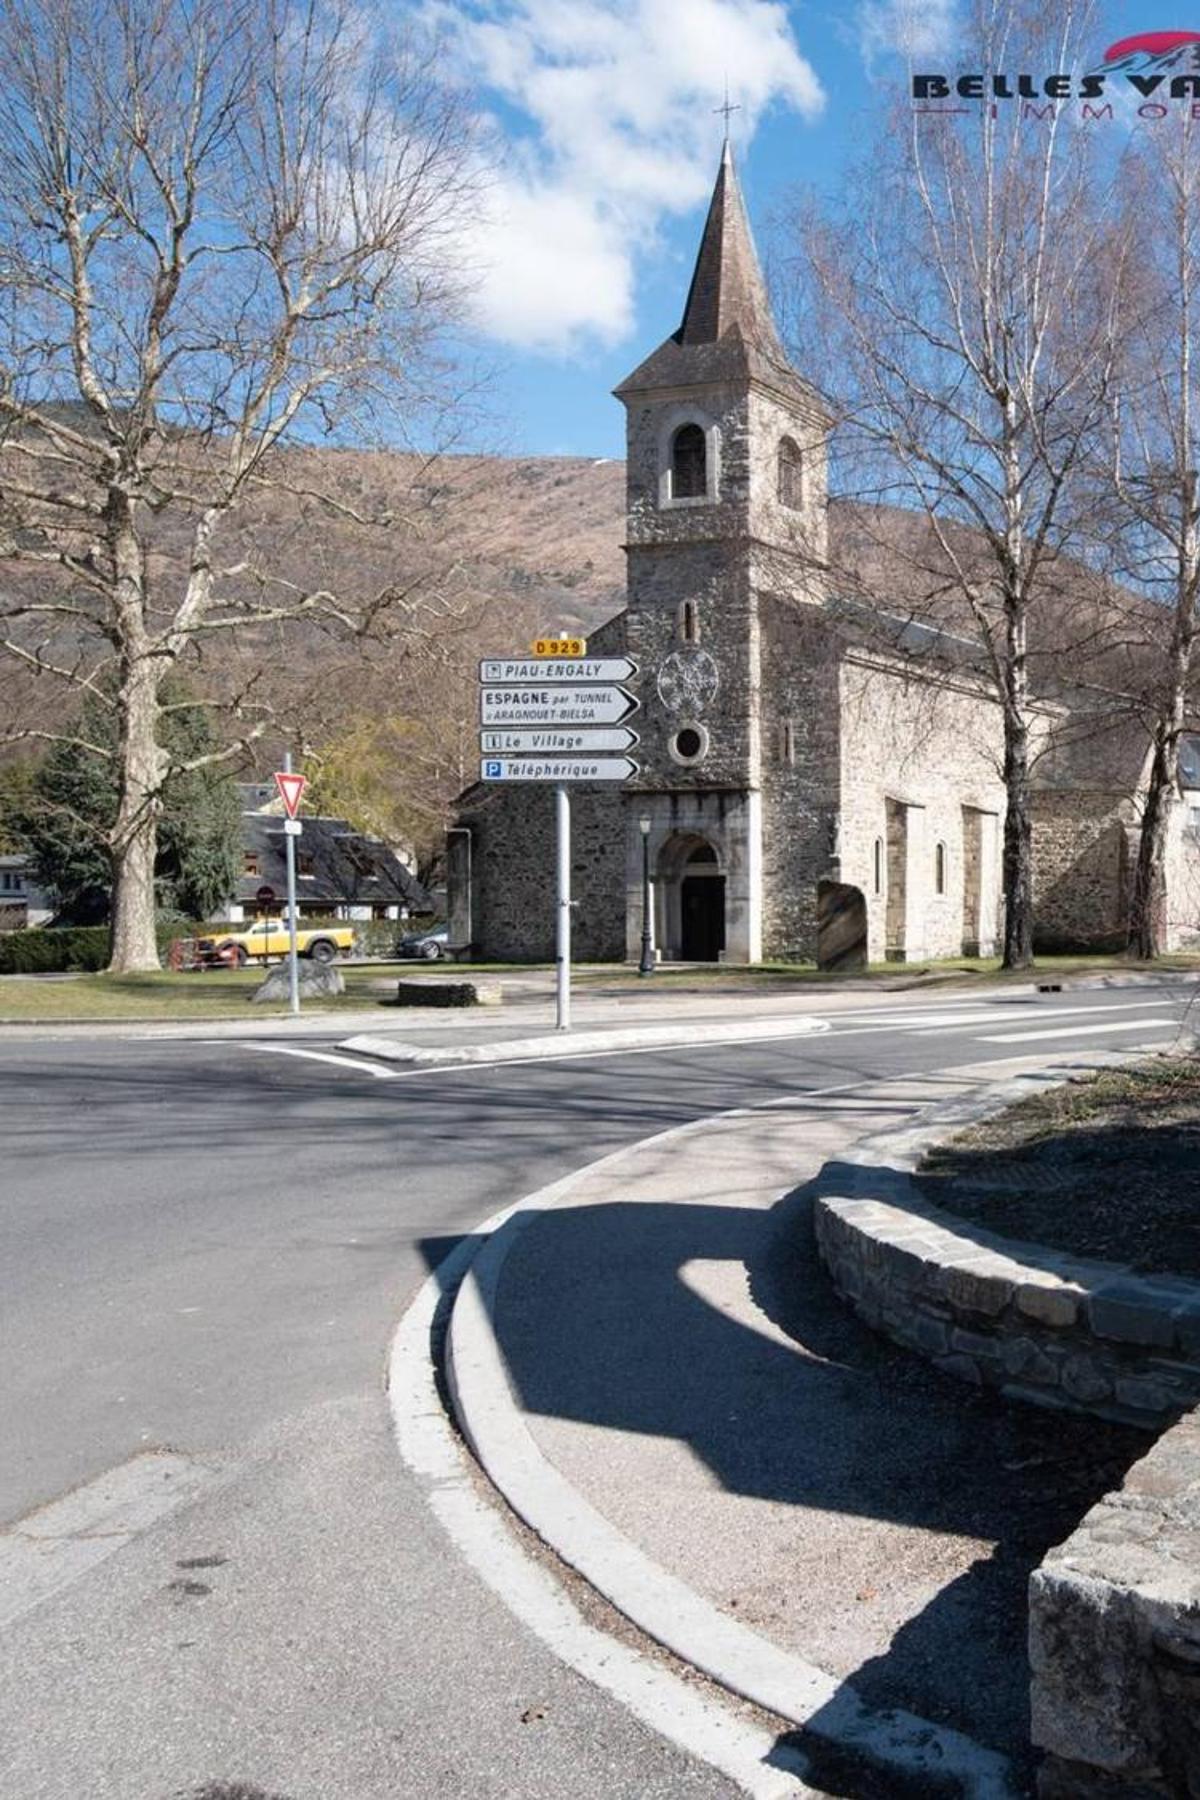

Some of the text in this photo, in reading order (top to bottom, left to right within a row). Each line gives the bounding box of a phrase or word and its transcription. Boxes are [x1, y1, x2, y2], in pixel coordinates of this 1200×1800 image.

[536, 641, 581, 654] D 929
[505, 664, 602, 677] PIAU-ENGALY
[486, 692, 612, 706] ESPAGNE par TUNNEL
[505, 736, 521, 748] Le
[532, 735, 583, 749] Village
[507, 764, 598, 777] Téléphérique
